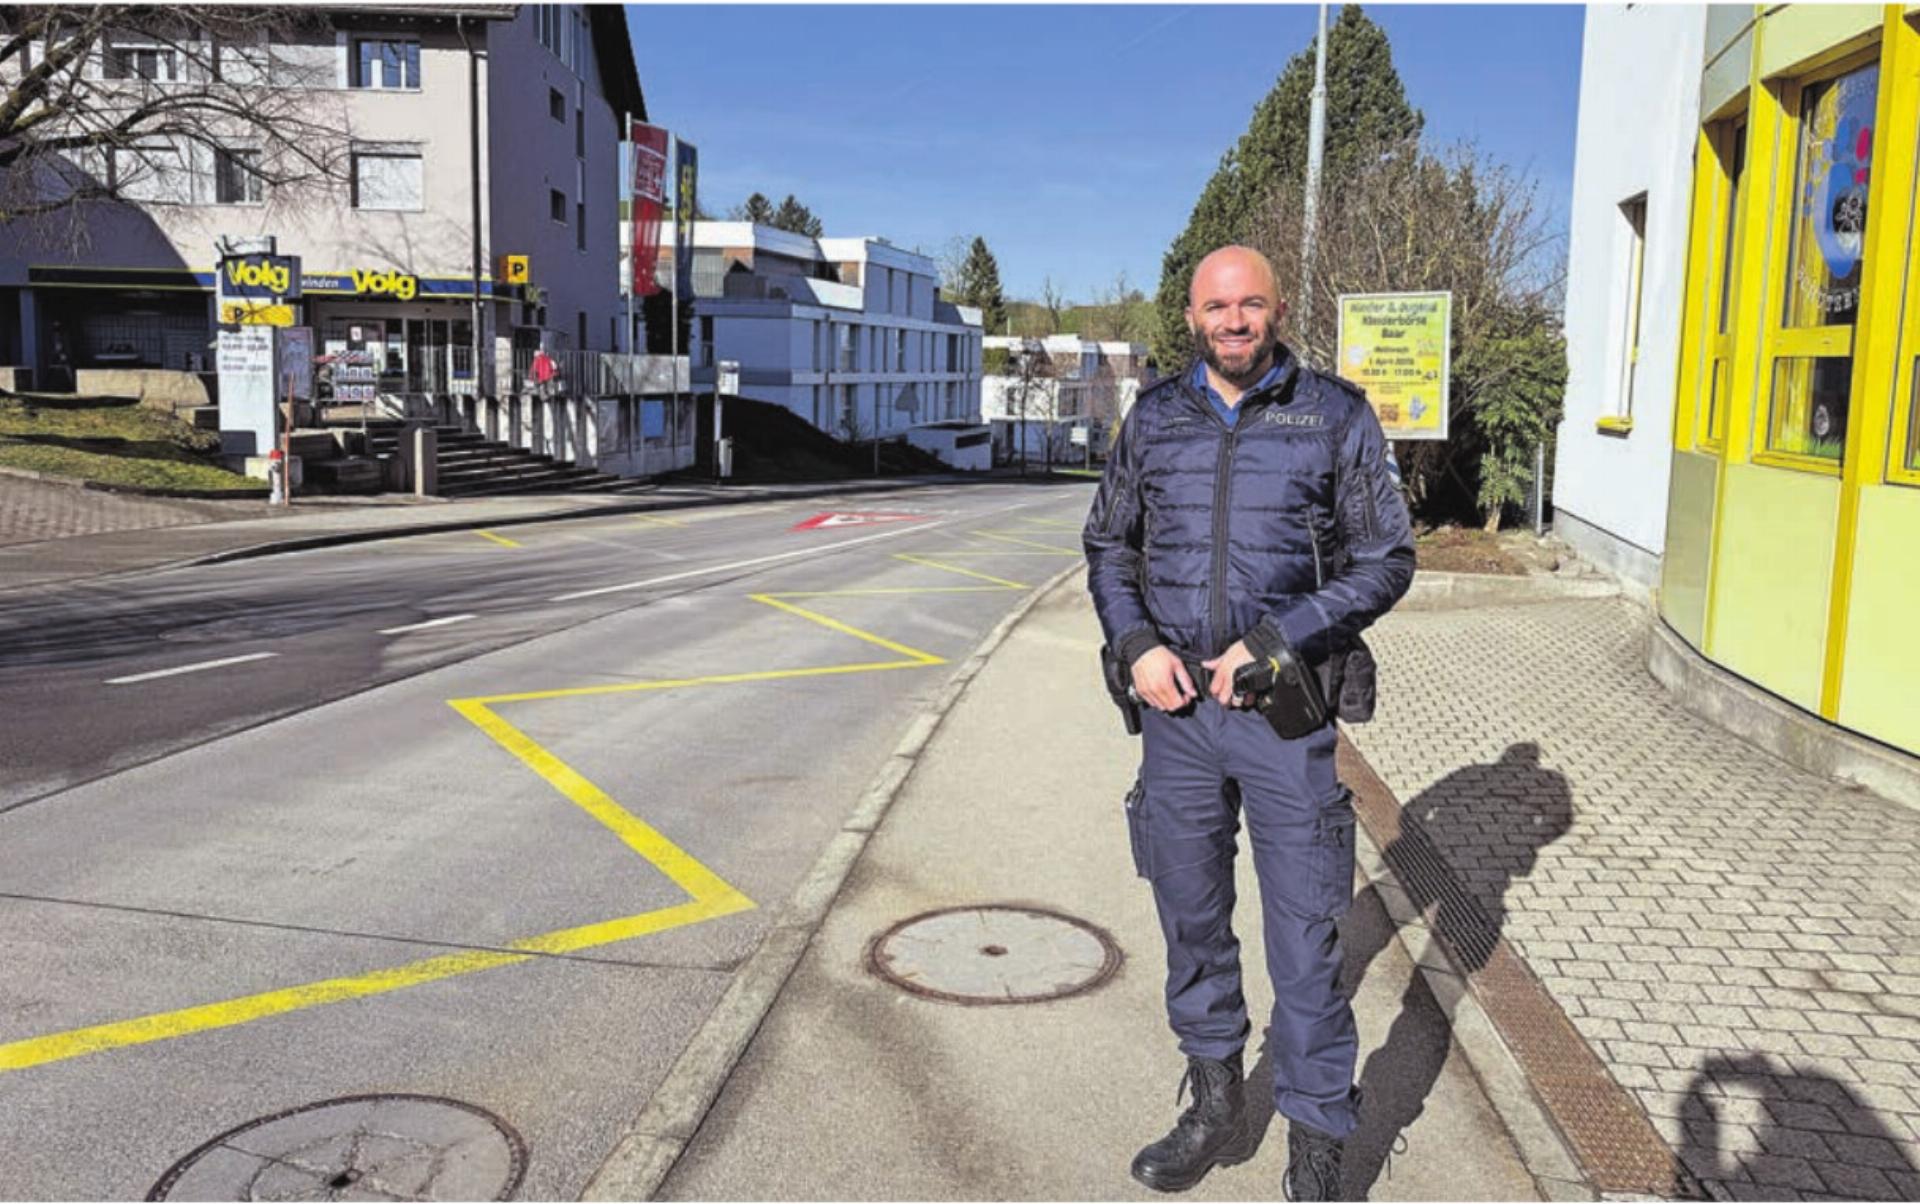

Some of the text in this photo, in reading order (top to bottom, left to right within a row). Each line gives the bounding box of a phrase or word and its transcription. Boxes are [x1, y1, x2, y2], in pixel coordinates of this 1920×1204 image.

[226, 259, 290, 293] Volg
[512, 262, 524, 276] P
[351, 267, 416, 299] Volg
[1265, 411, 1324, 426] POLIZEI
